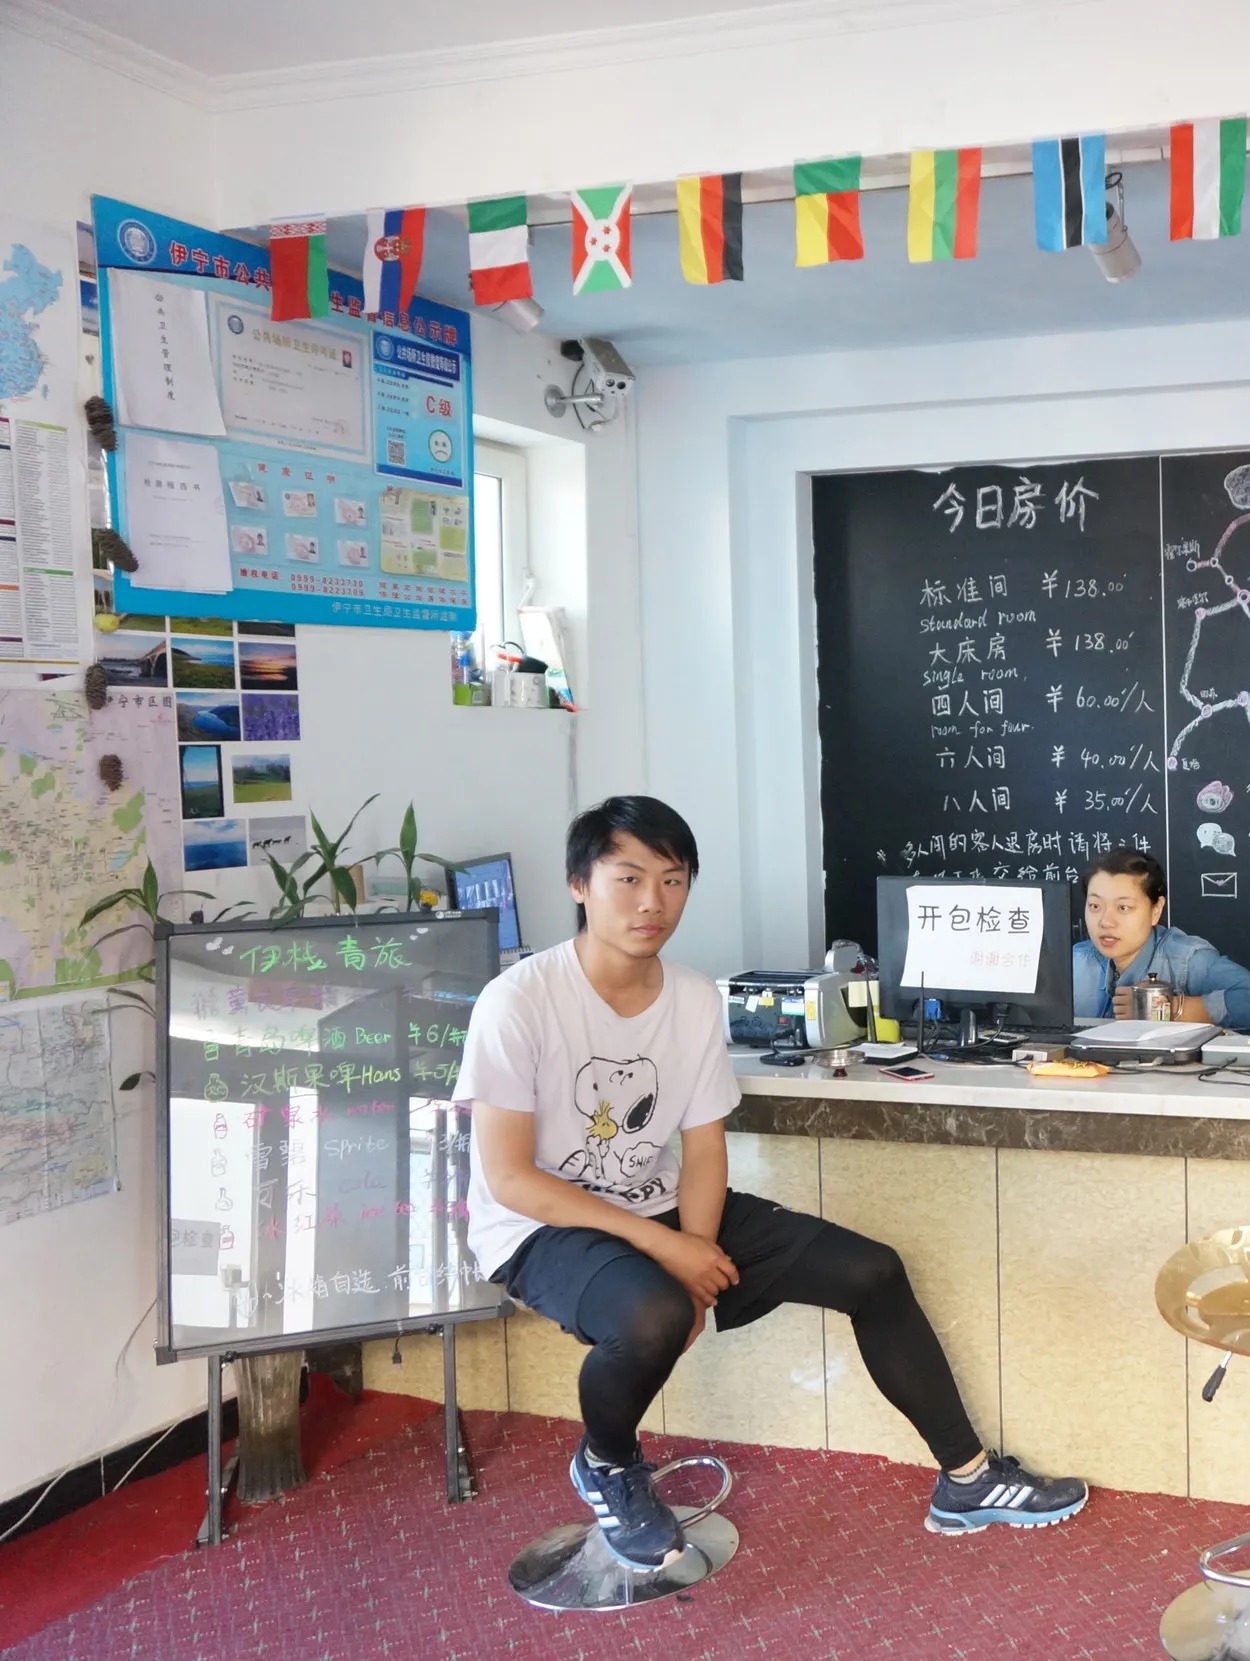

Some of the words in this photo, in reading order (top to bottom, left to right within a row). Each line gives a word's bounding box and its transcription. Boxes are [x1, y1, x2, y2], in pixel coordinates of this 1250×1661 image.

[933, 476, 1099, 533] 今日房价
[919, 575, 1008, 607] 标准间
[998, 610, 1037, 625] room
[929, 632, 1007, 667] 大床房
[931, 687, 1004, 717] 四人间
[936, 745, 1006, 770] 六人间
[943, 786, 1011, 813] 八人间
[917, 904, 1030, 934] 开包检查
[239, 935, 413, 973] 伊栈青旅
[970, 950, 1031, 969] 谢谢合作
[231, 1026, 346, 1058] 青岛啤酒
[354, 1027, 392, 1045] Beer
[240, 1060, 361, 1098] 汉斯果啤
[360, 1065, 401, 1087] Hans
[243, 1103, 336, 1129] 矿泉水
[247, 1139, 307, 1171] 雪碧
[324, 1135, 389, 1161] Sprite
[258, 1176, 318, 1208] 可乐
